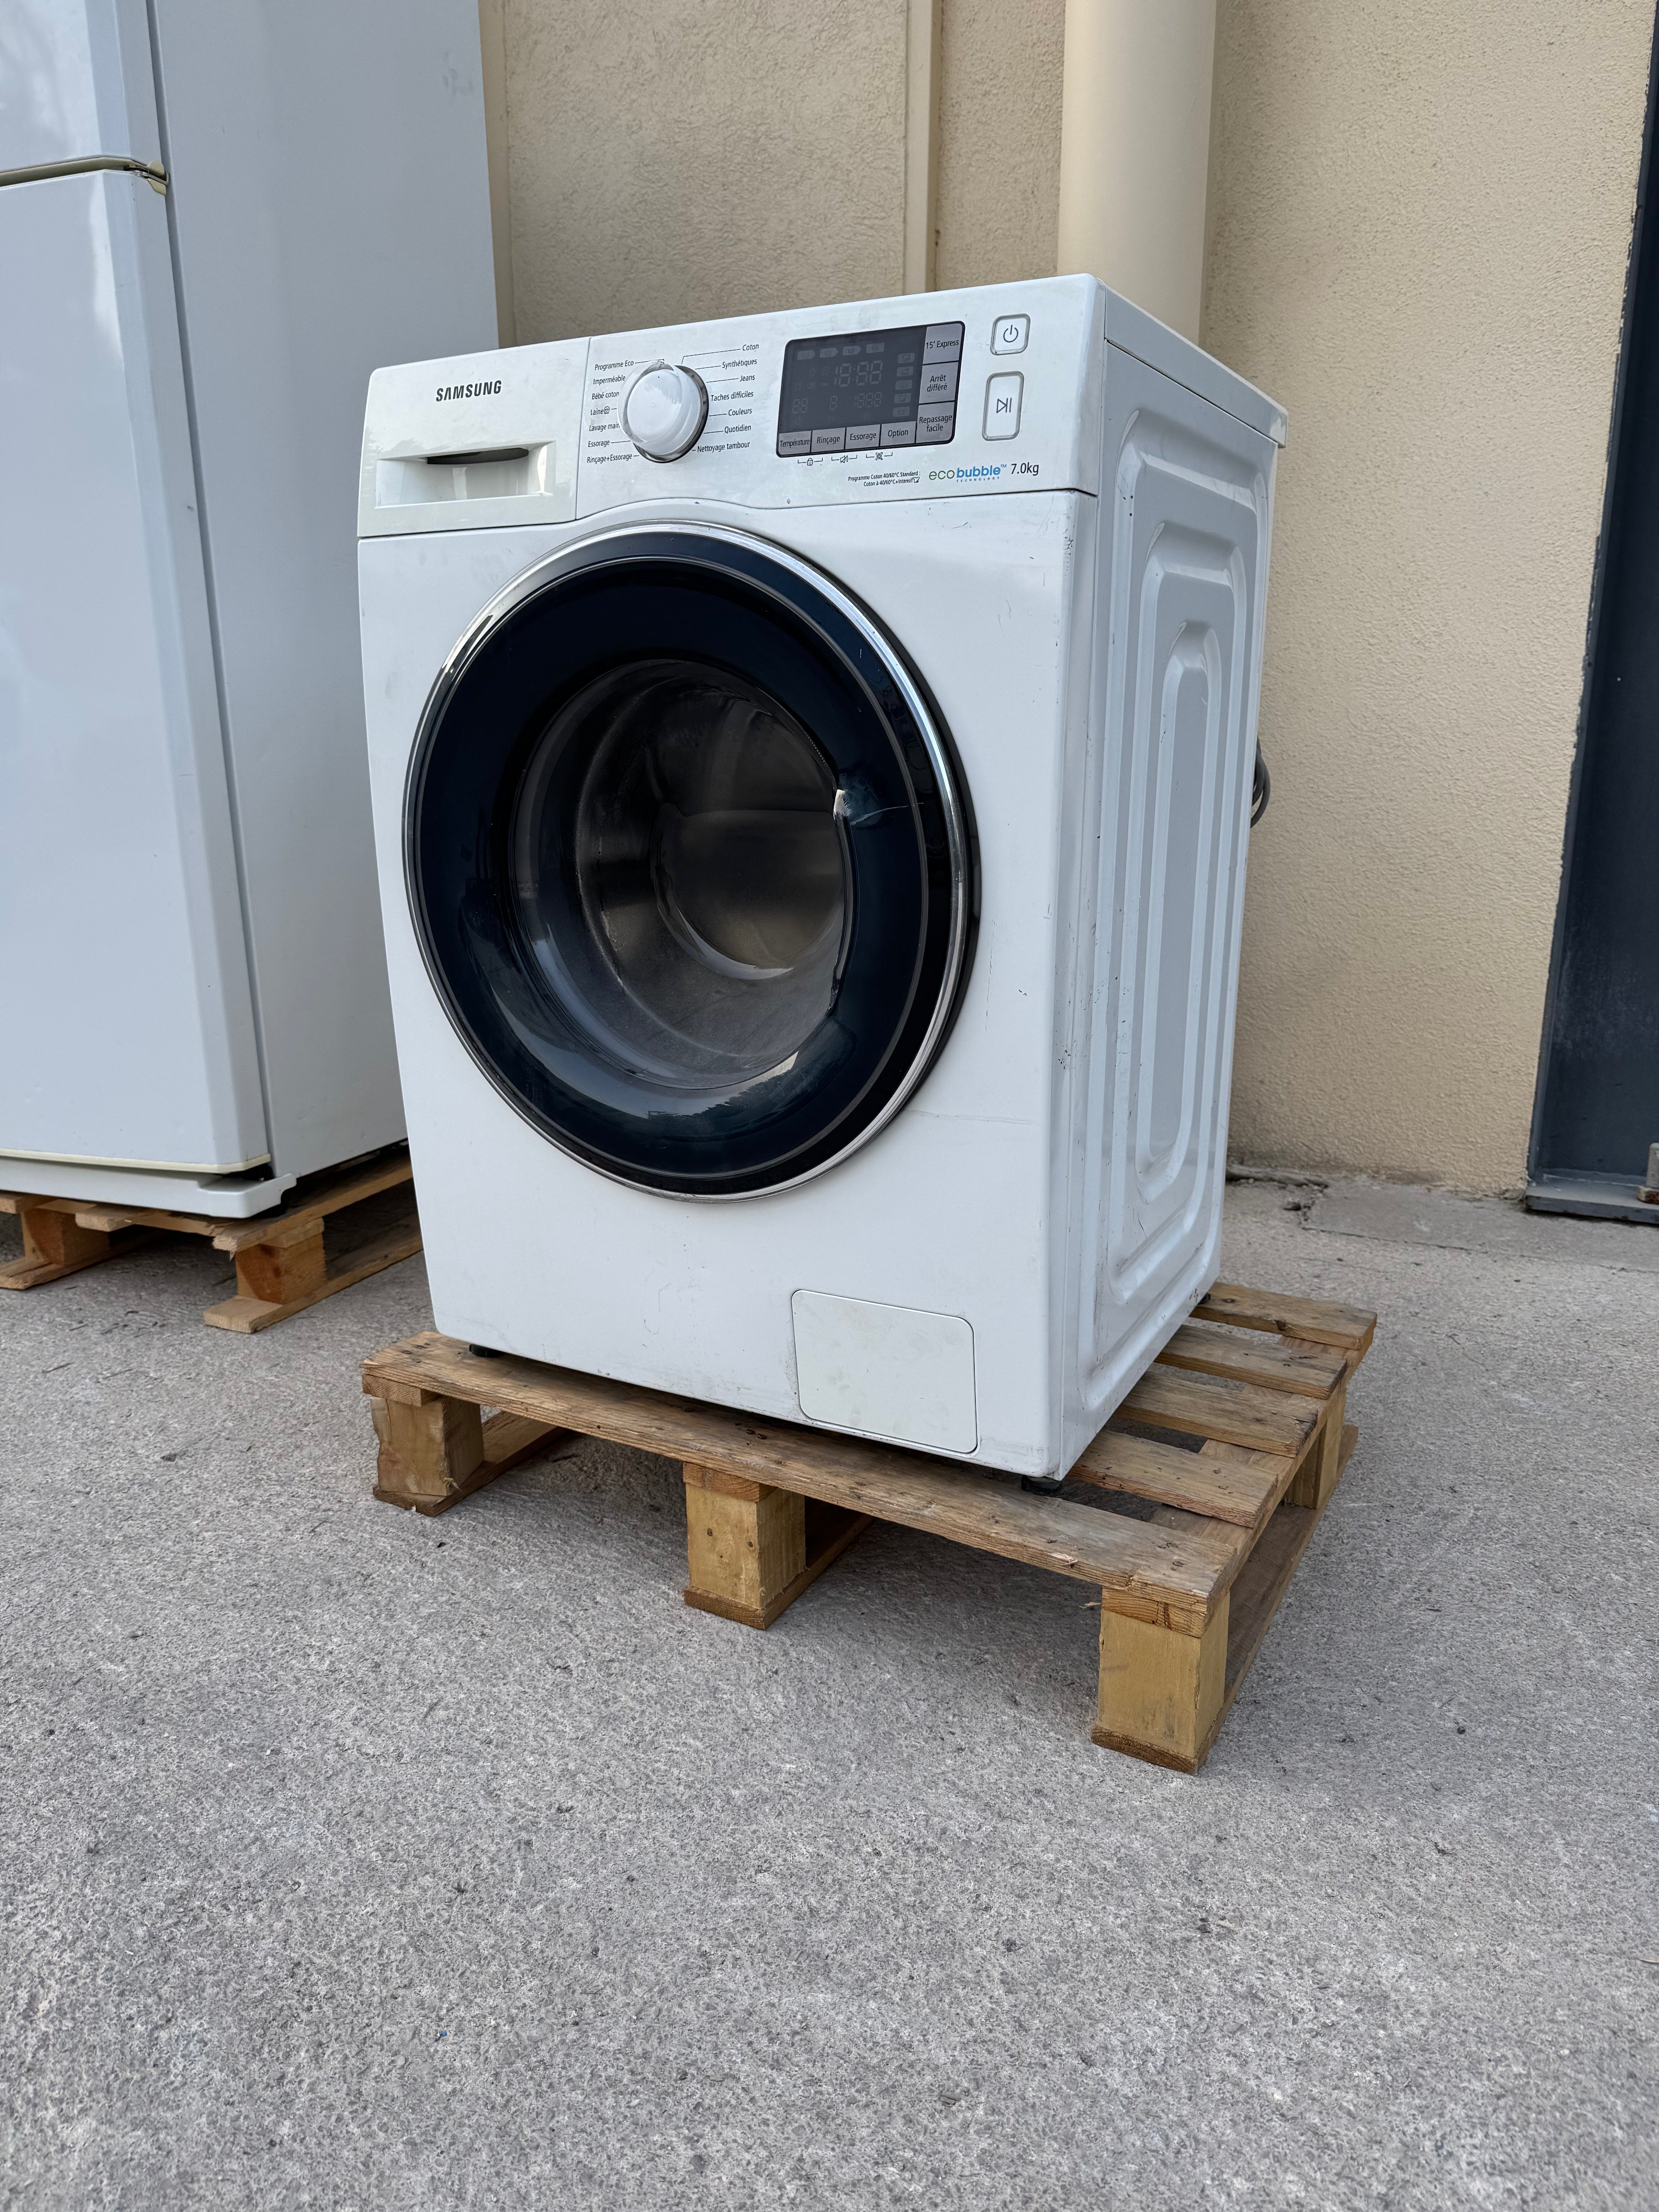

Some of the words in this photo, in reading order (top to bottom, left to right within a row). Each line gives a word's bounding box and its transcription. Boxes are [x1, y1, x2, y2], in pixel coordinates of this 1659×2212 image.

[937, 340, 959, 349] Express
[595, 361, 623, 371] Programme
[722, 359, 757, 369] Synthétiques
[593, 374, 626, 386] Imperméable
[930, 374, 946, 383] Arrêt
[436, 380, 501, 402] SAMSUNG
[927, 383, 947, 392] différé
[592, 391, 604, 399] Bébé
[731, 390, 754, 399] difficiles
[919, 415, 952, 425] Repassage
[725, 424, 751, 434] Quotidien
[927, 424, 943, 432] facile
[850, 433, 876, 441] Essorage
[888, 429, 908, 438] Option
[780, 439, 810, 448] Température
[697, 445, 725, 453] Nettoyage
[587, 453, 632, 464] Rinçage+Essorage
[1011, 462, 1039, 476] 7.0kg
